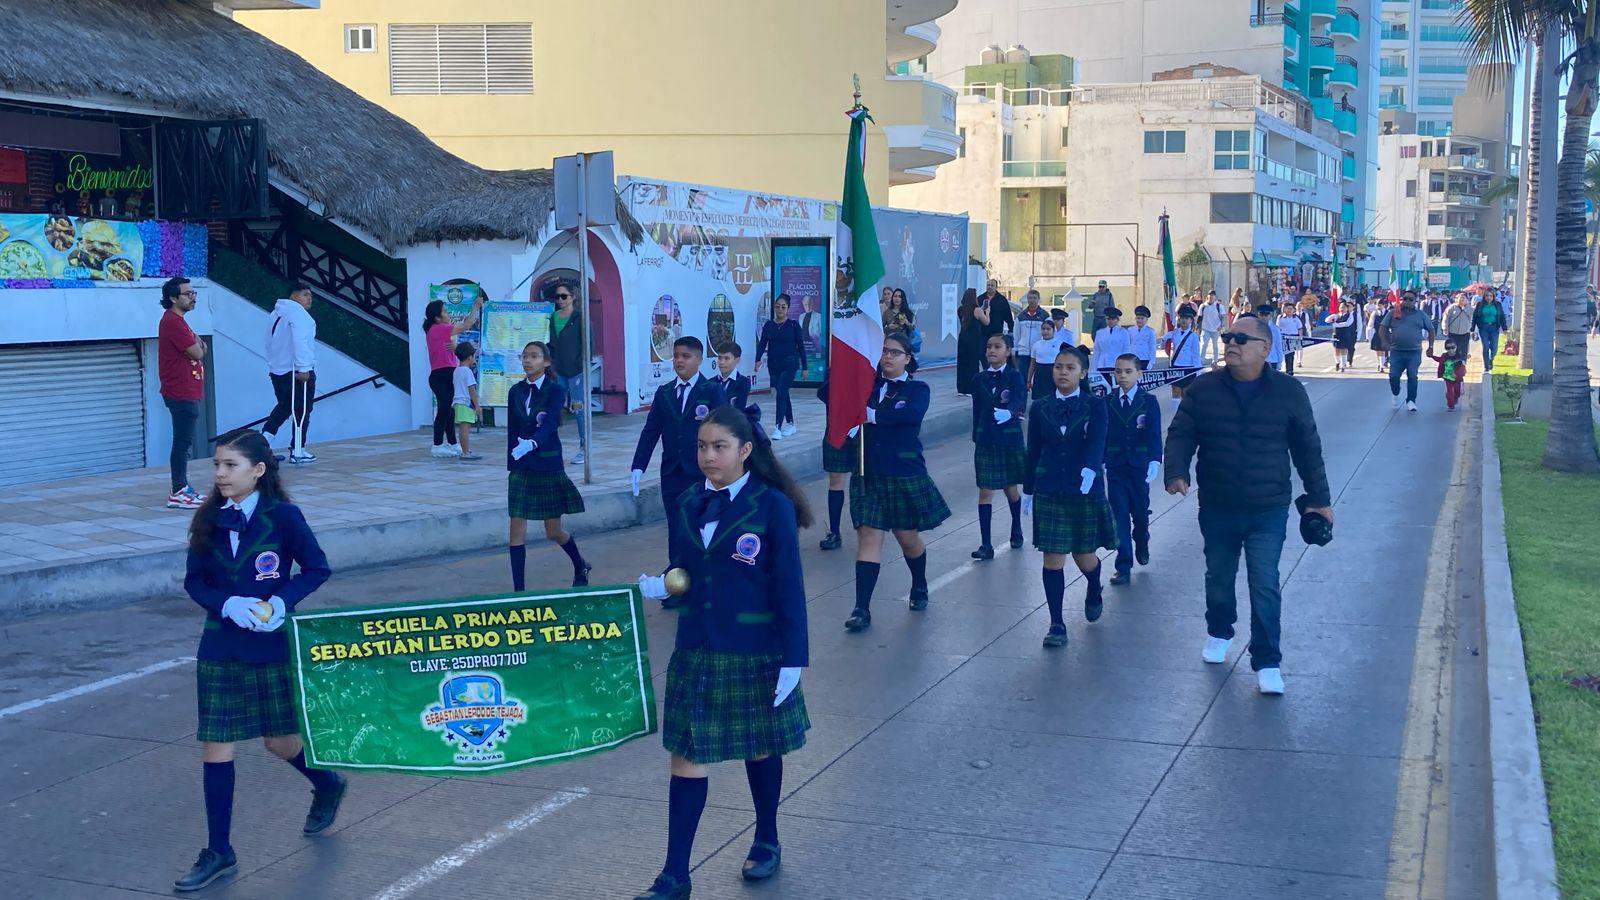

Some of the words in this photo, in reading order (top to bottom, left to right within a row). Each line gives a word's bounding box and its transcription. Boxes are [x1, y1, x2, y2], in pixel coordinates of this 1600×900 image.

[67, 154, 153, 191] Bienvenidos
[362, 616, 449, 636] ESCUELA
[453, 607, 558, 629] PRIMARIA
[310, 635, 424, 662] SEBASTIÁN
[428, 631, 501, 652] LERDO
[506, 628, 535, 646] DE
[540, 623, 622, 643] TEJADA
[497, 706, 523, 719] TEJADA
